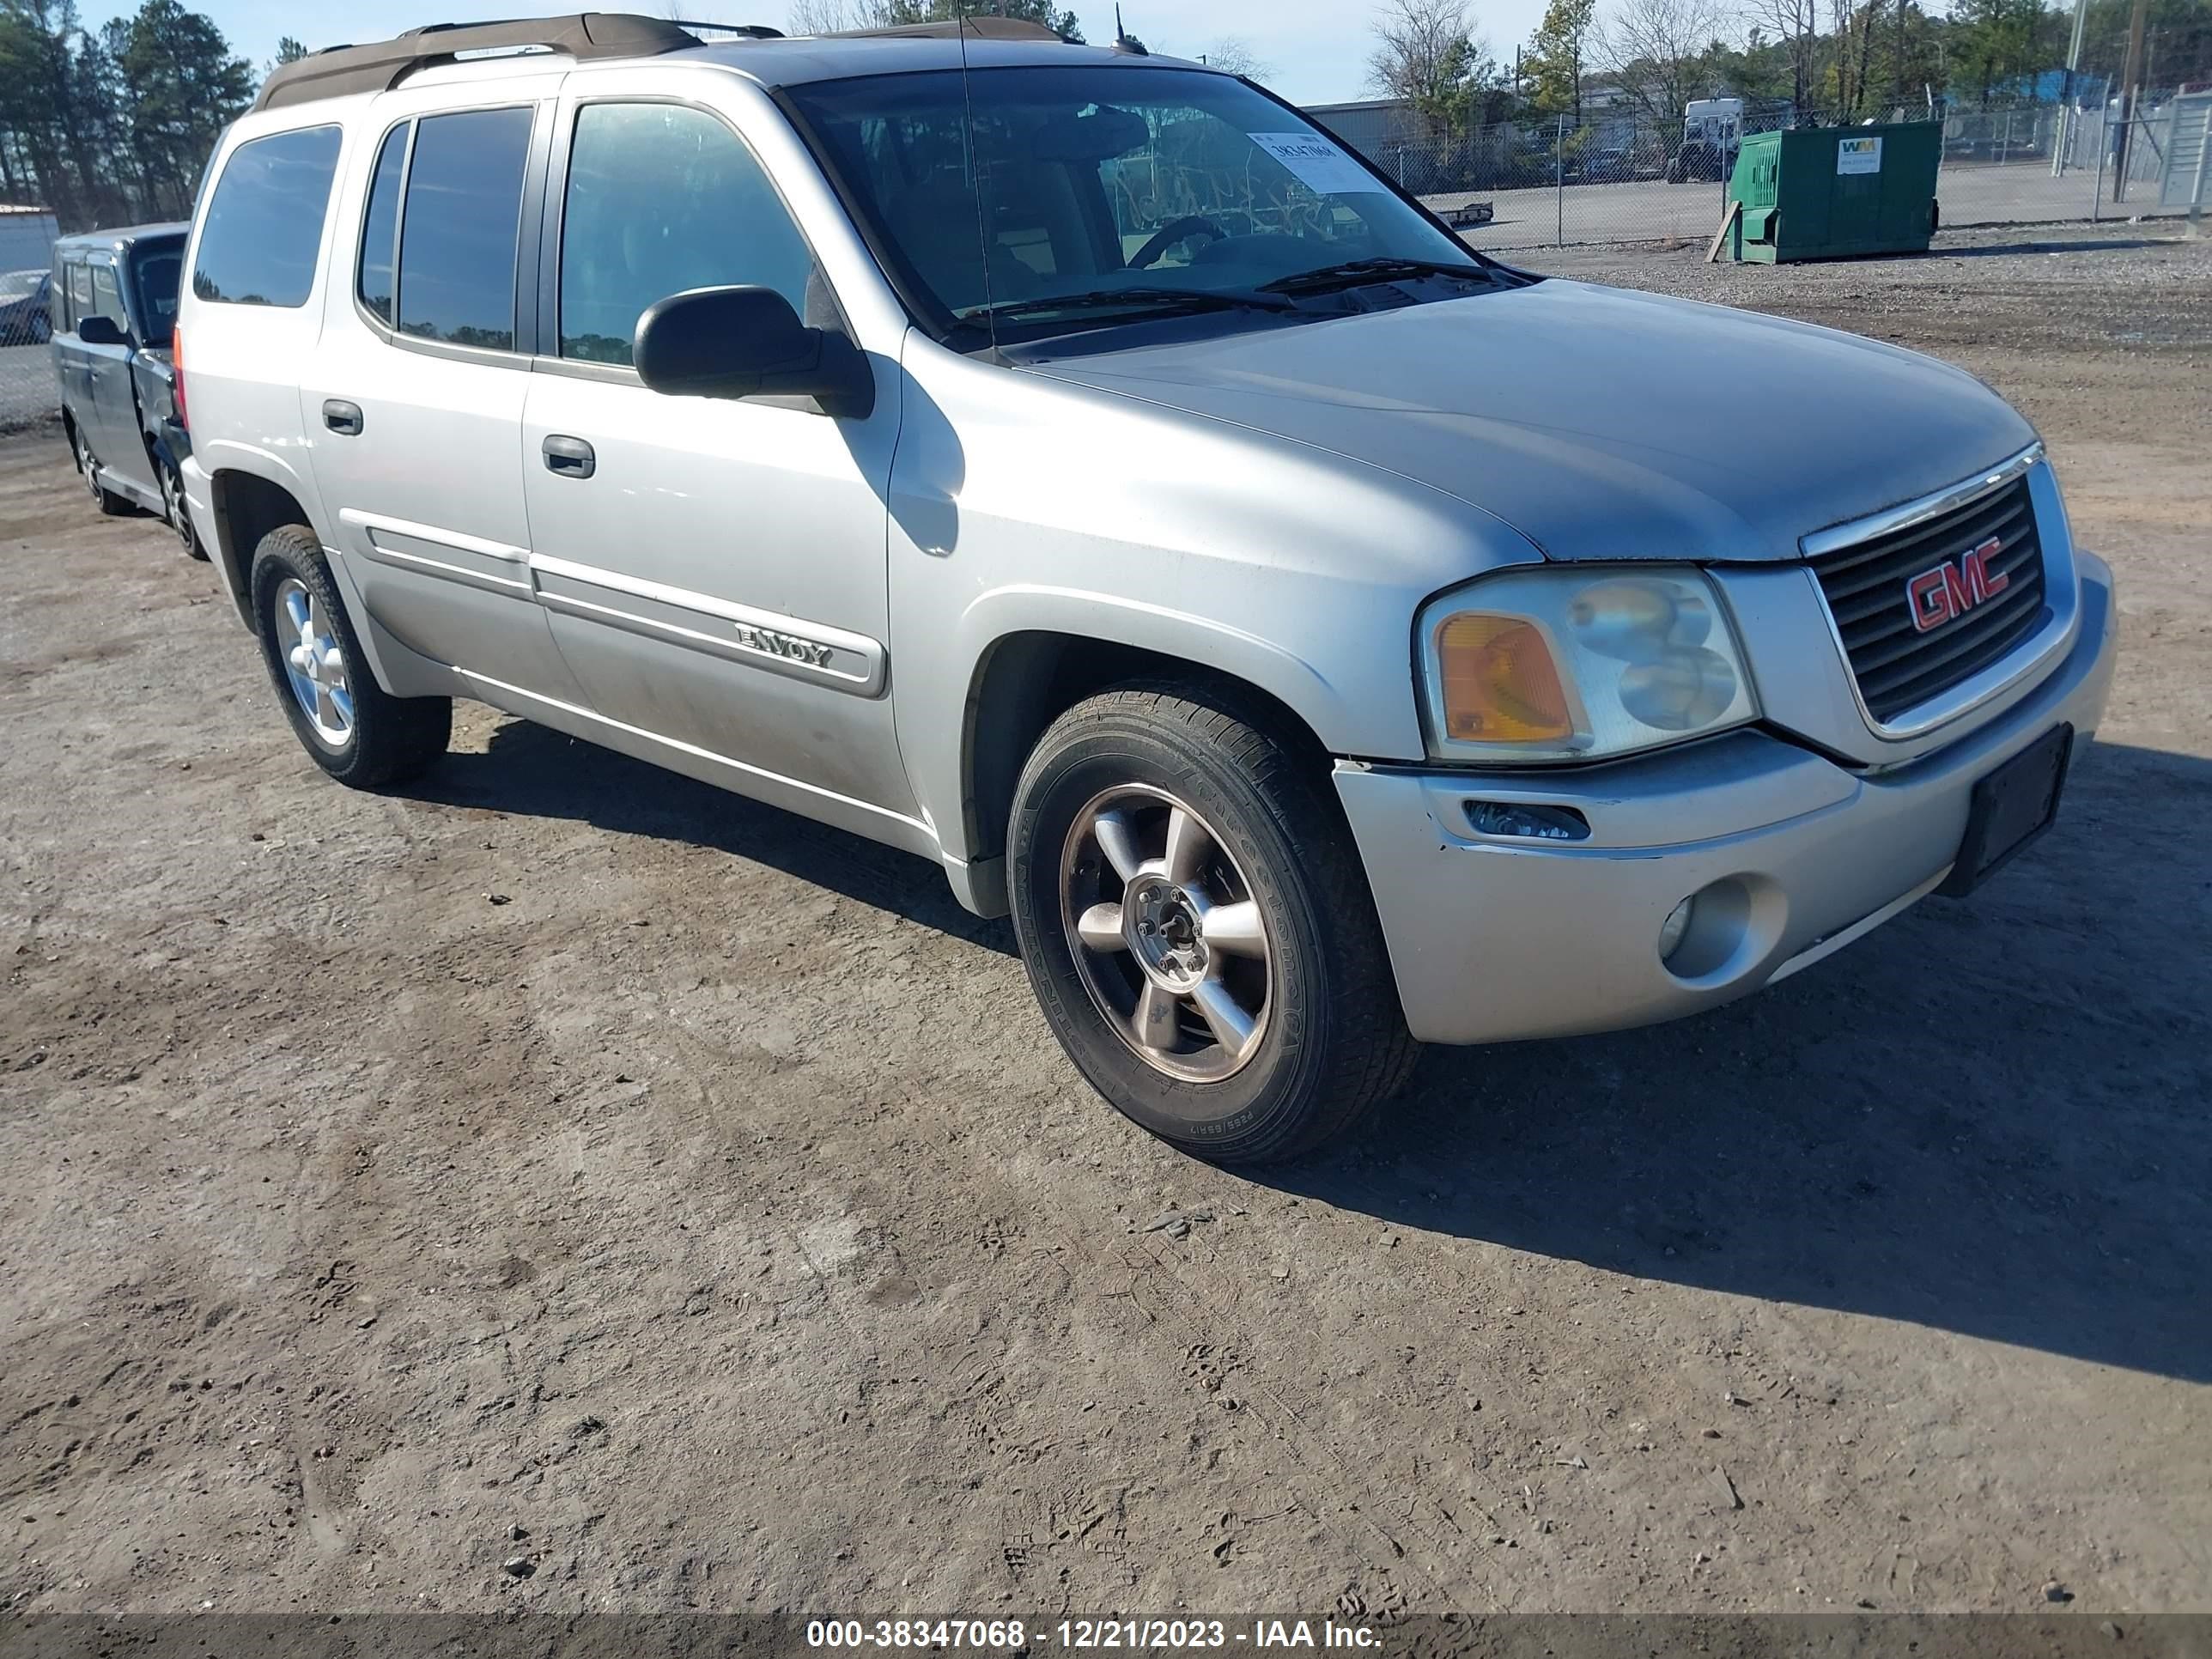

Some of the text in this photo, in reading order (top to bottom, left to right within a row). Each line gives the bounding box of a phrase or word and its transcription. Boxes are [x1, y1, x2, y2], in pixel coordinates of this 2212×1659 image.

[1271, 144, 1338, 158] 38347068
[1905, 536, 2009, 634] GMC
[734, 623, 834, 668] ENVOY
